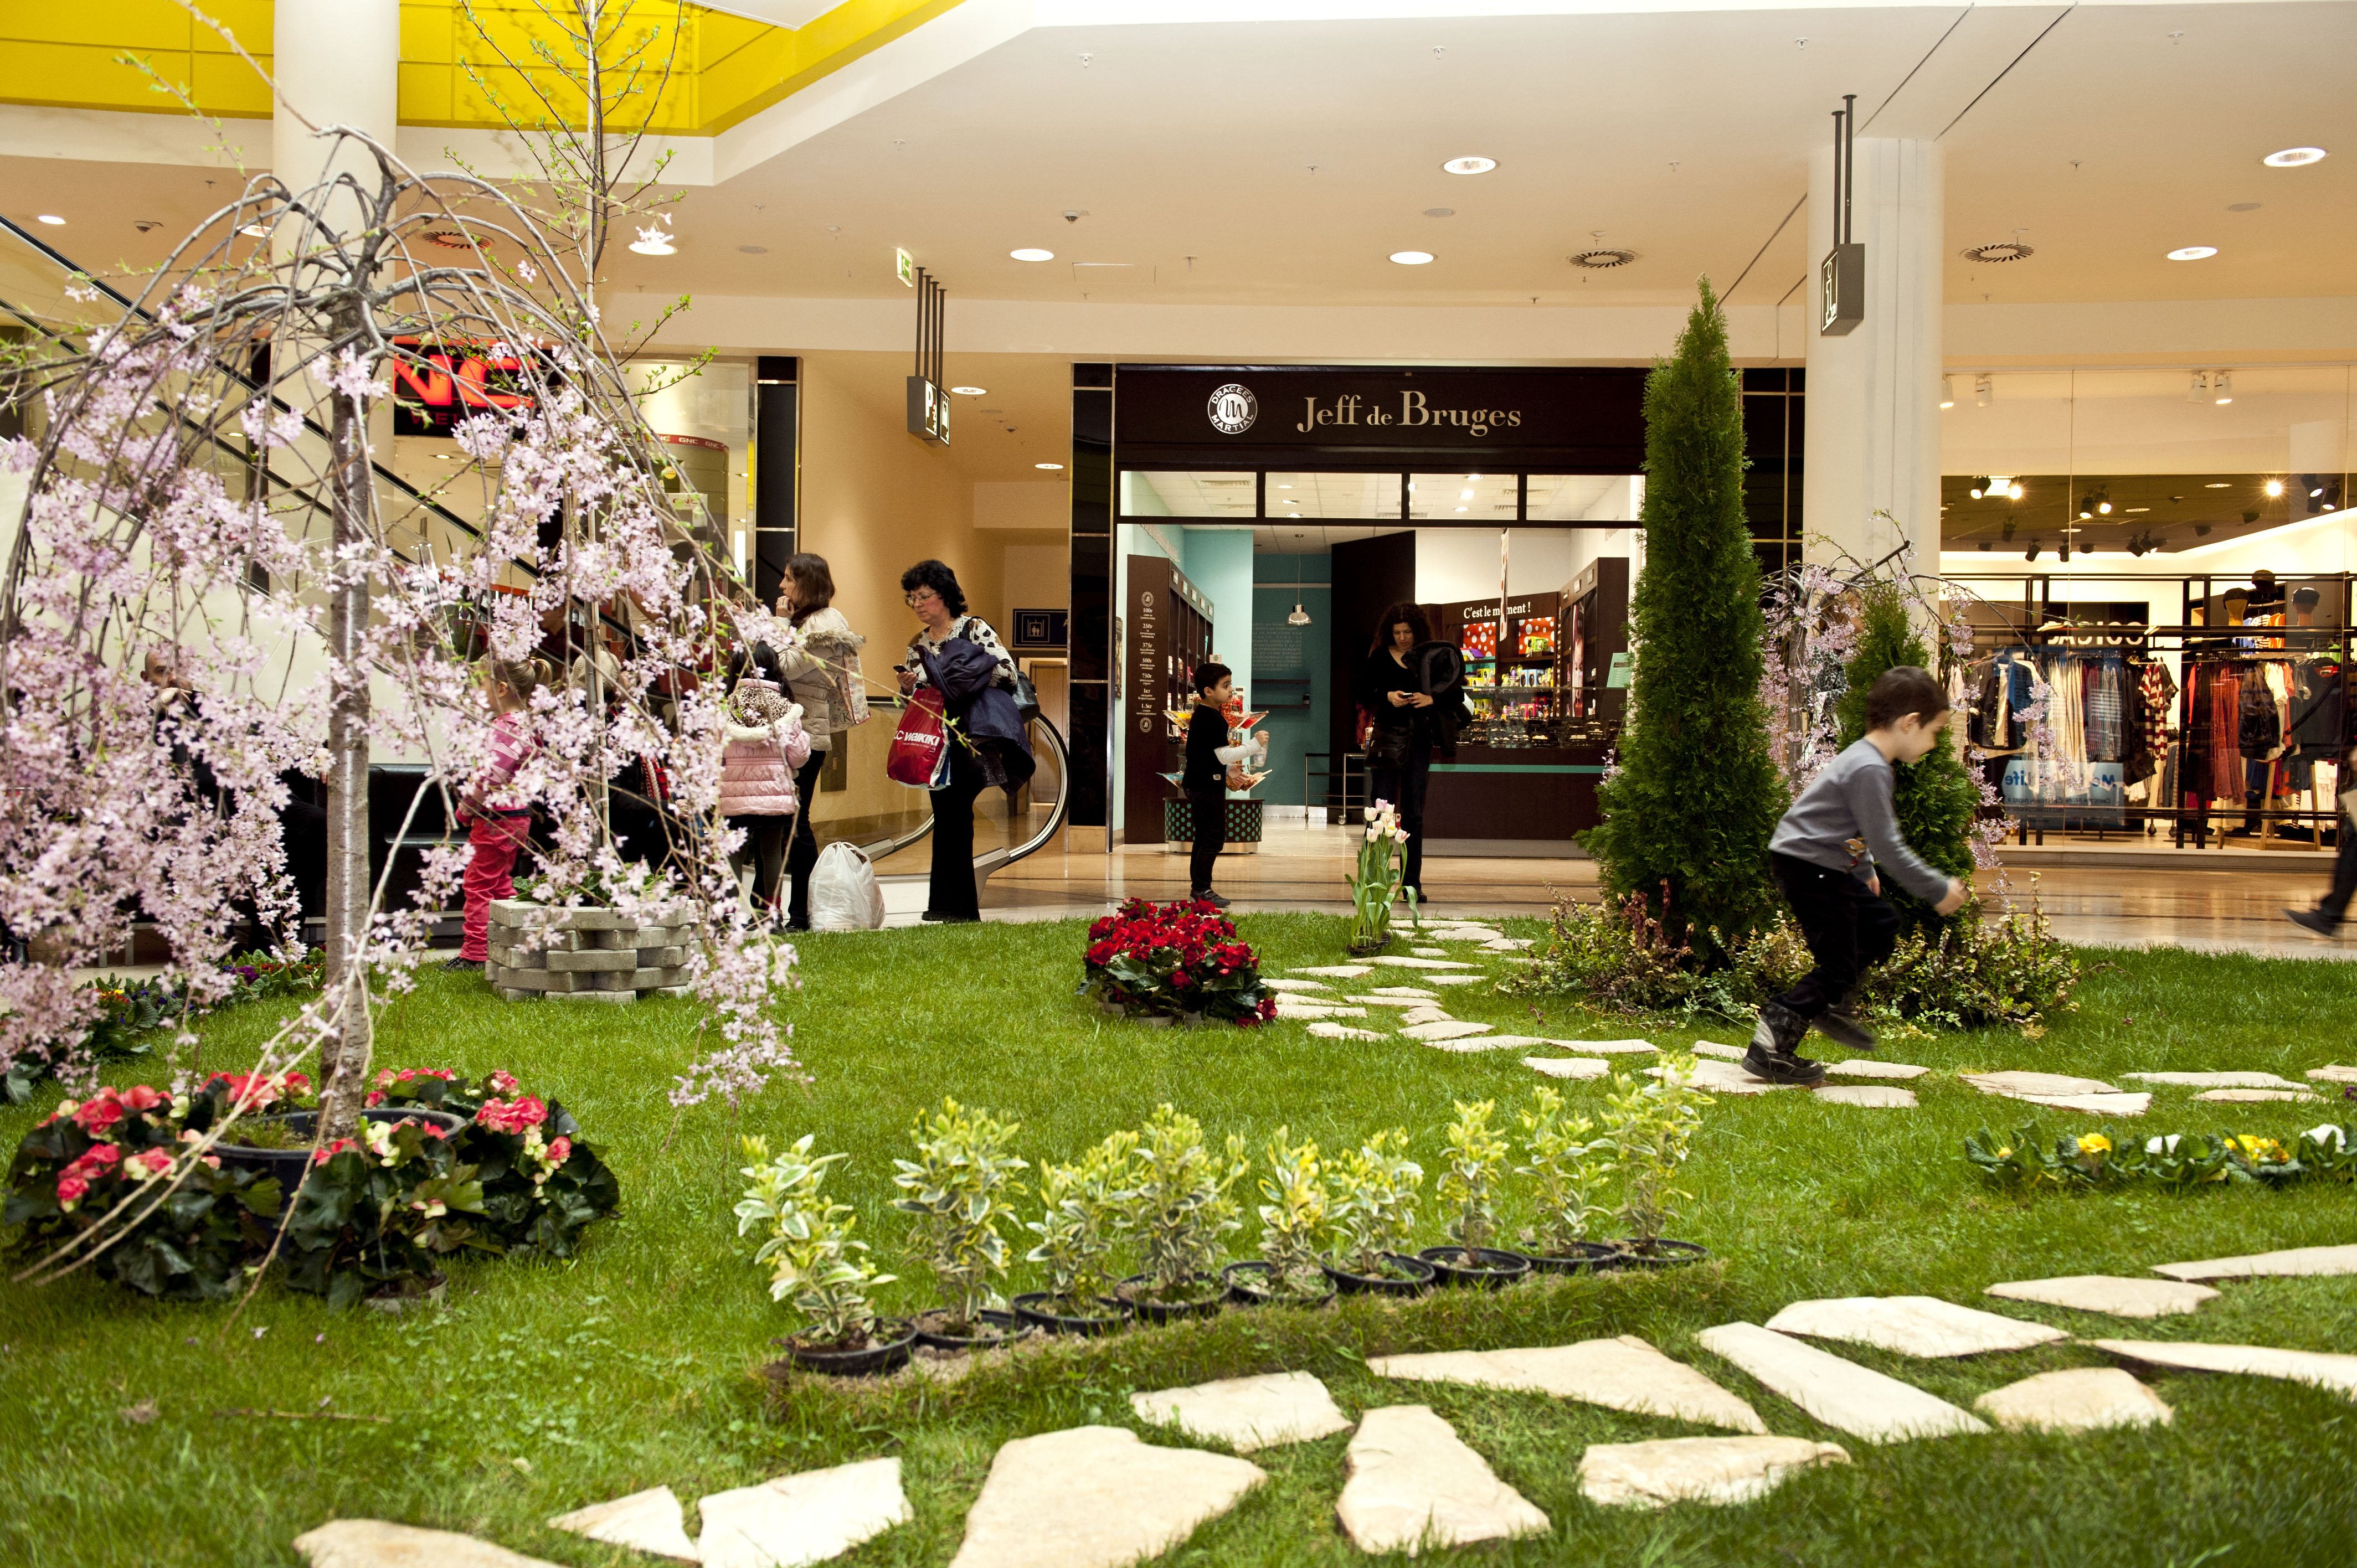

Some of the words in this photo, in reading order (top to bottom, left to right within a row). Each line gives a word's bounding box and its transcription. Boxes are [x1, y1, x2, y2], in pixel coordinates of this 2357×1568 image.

[1211, 386, 1253, 404] DRAGEES
[1297, 394, 1362, 432] Jeff
[1366, 405, 1393, 426] de
[1396, 390, 1521, 437] Bruges
[1211, 414, 1254, 431] MARTIAL
[1464, 607, 1483, 619] C'est
[1484, 605, 1491, 617] le
[1493, 604, 1526, 616] mment
